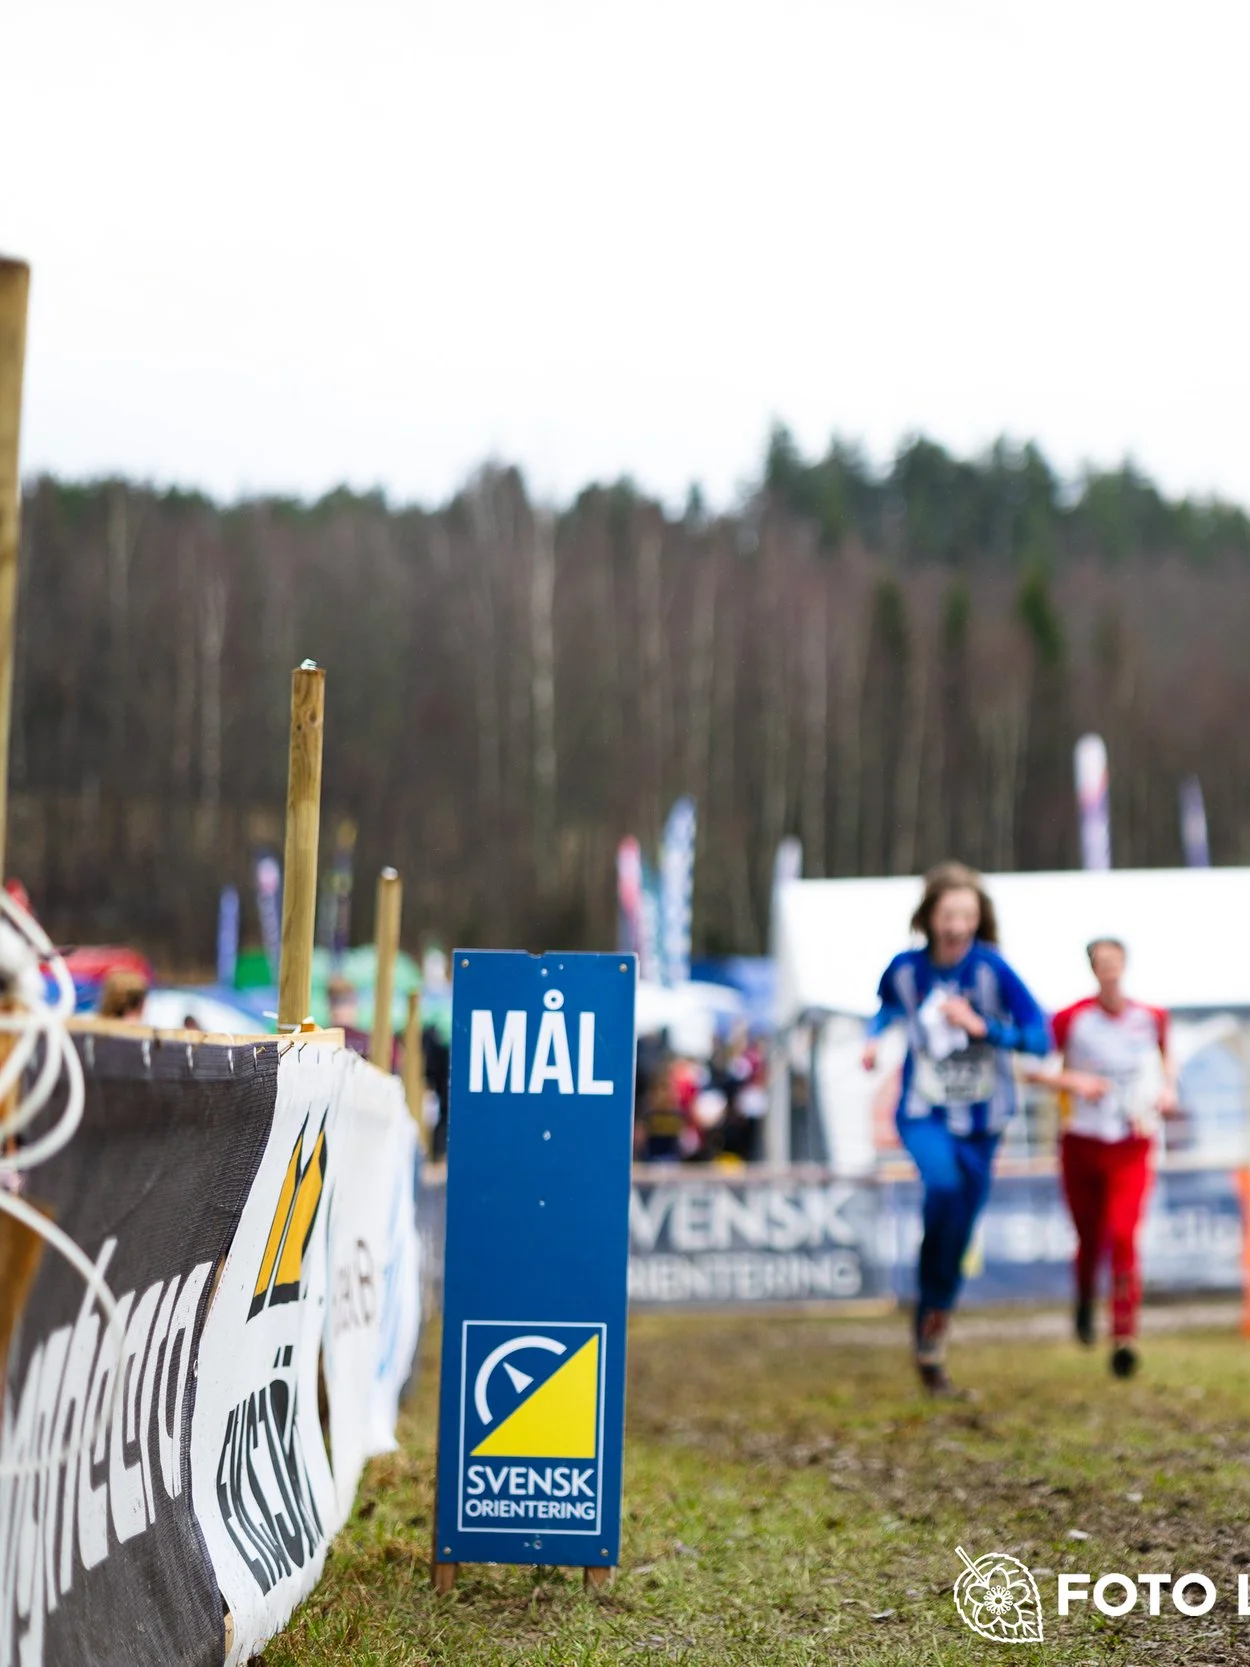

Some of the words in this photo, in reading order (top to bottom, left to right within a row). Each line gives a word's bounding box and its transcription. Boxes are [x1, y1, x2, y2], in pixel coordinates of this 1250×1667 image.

[469, 988, 615, 1096] MÅL
[630, 1184, 858, 1252] VENSK
[628, 1252, 862, 1301] RIENTERING
[466, 1464, 596, 1498] SVENSK
[464, 1498, 597, 1521] ORIENTERING
